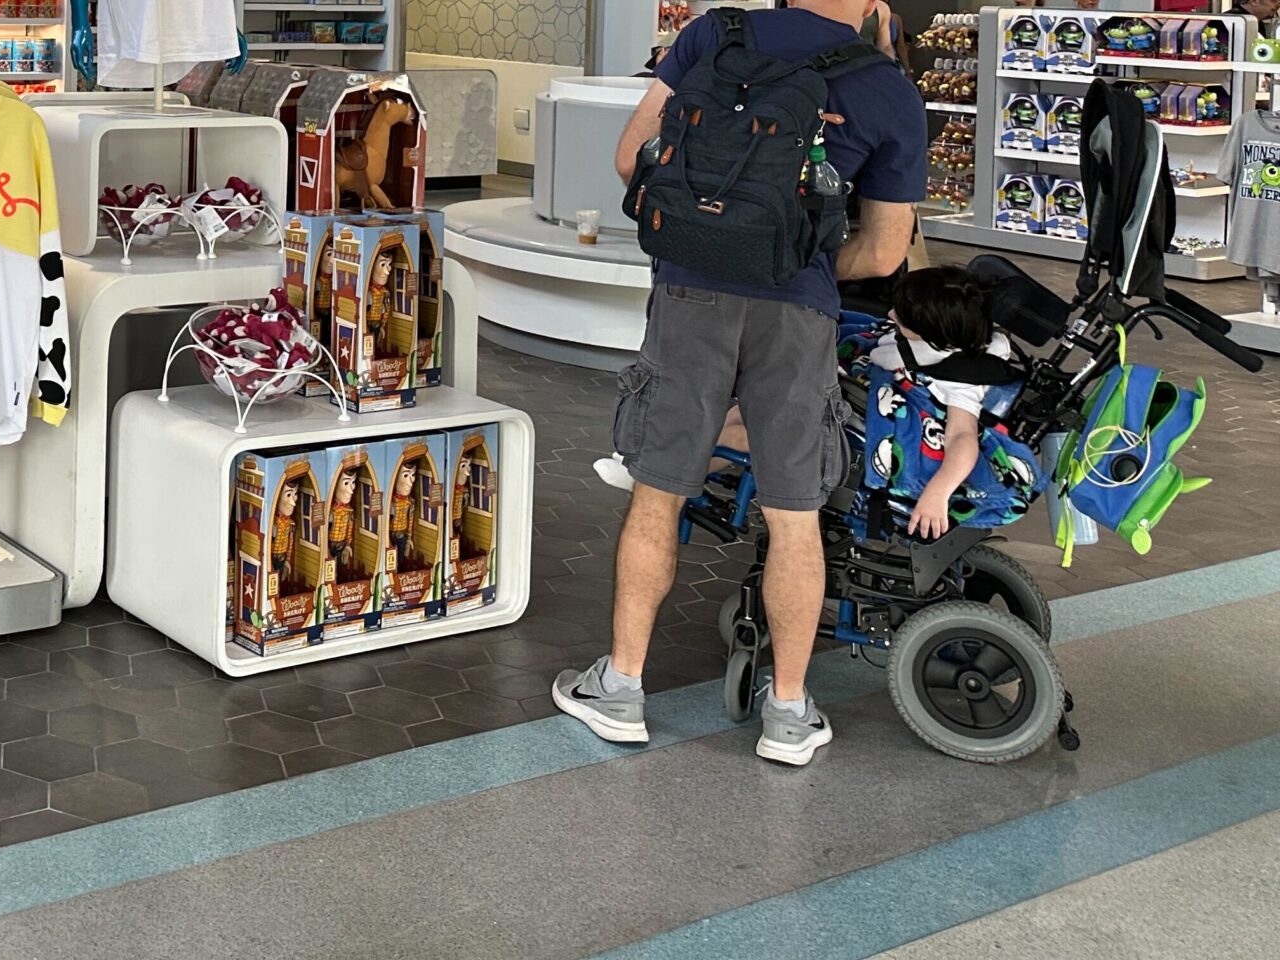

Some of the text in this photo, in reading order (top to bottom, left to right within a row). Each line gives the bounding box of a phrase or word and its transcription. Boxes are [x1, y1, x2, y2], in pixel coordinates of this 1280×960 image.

[304, 122, 318, 133] TOY
[1241, 187, 1280, 201] UNVER
[376, 360, 403, 373] Woody
[461, 559, 484, 574] Woody
[399, 572, 428, 587] Woody
[338, 582, 367, 598] Woody
[280, 596, 309, 611] Woody
